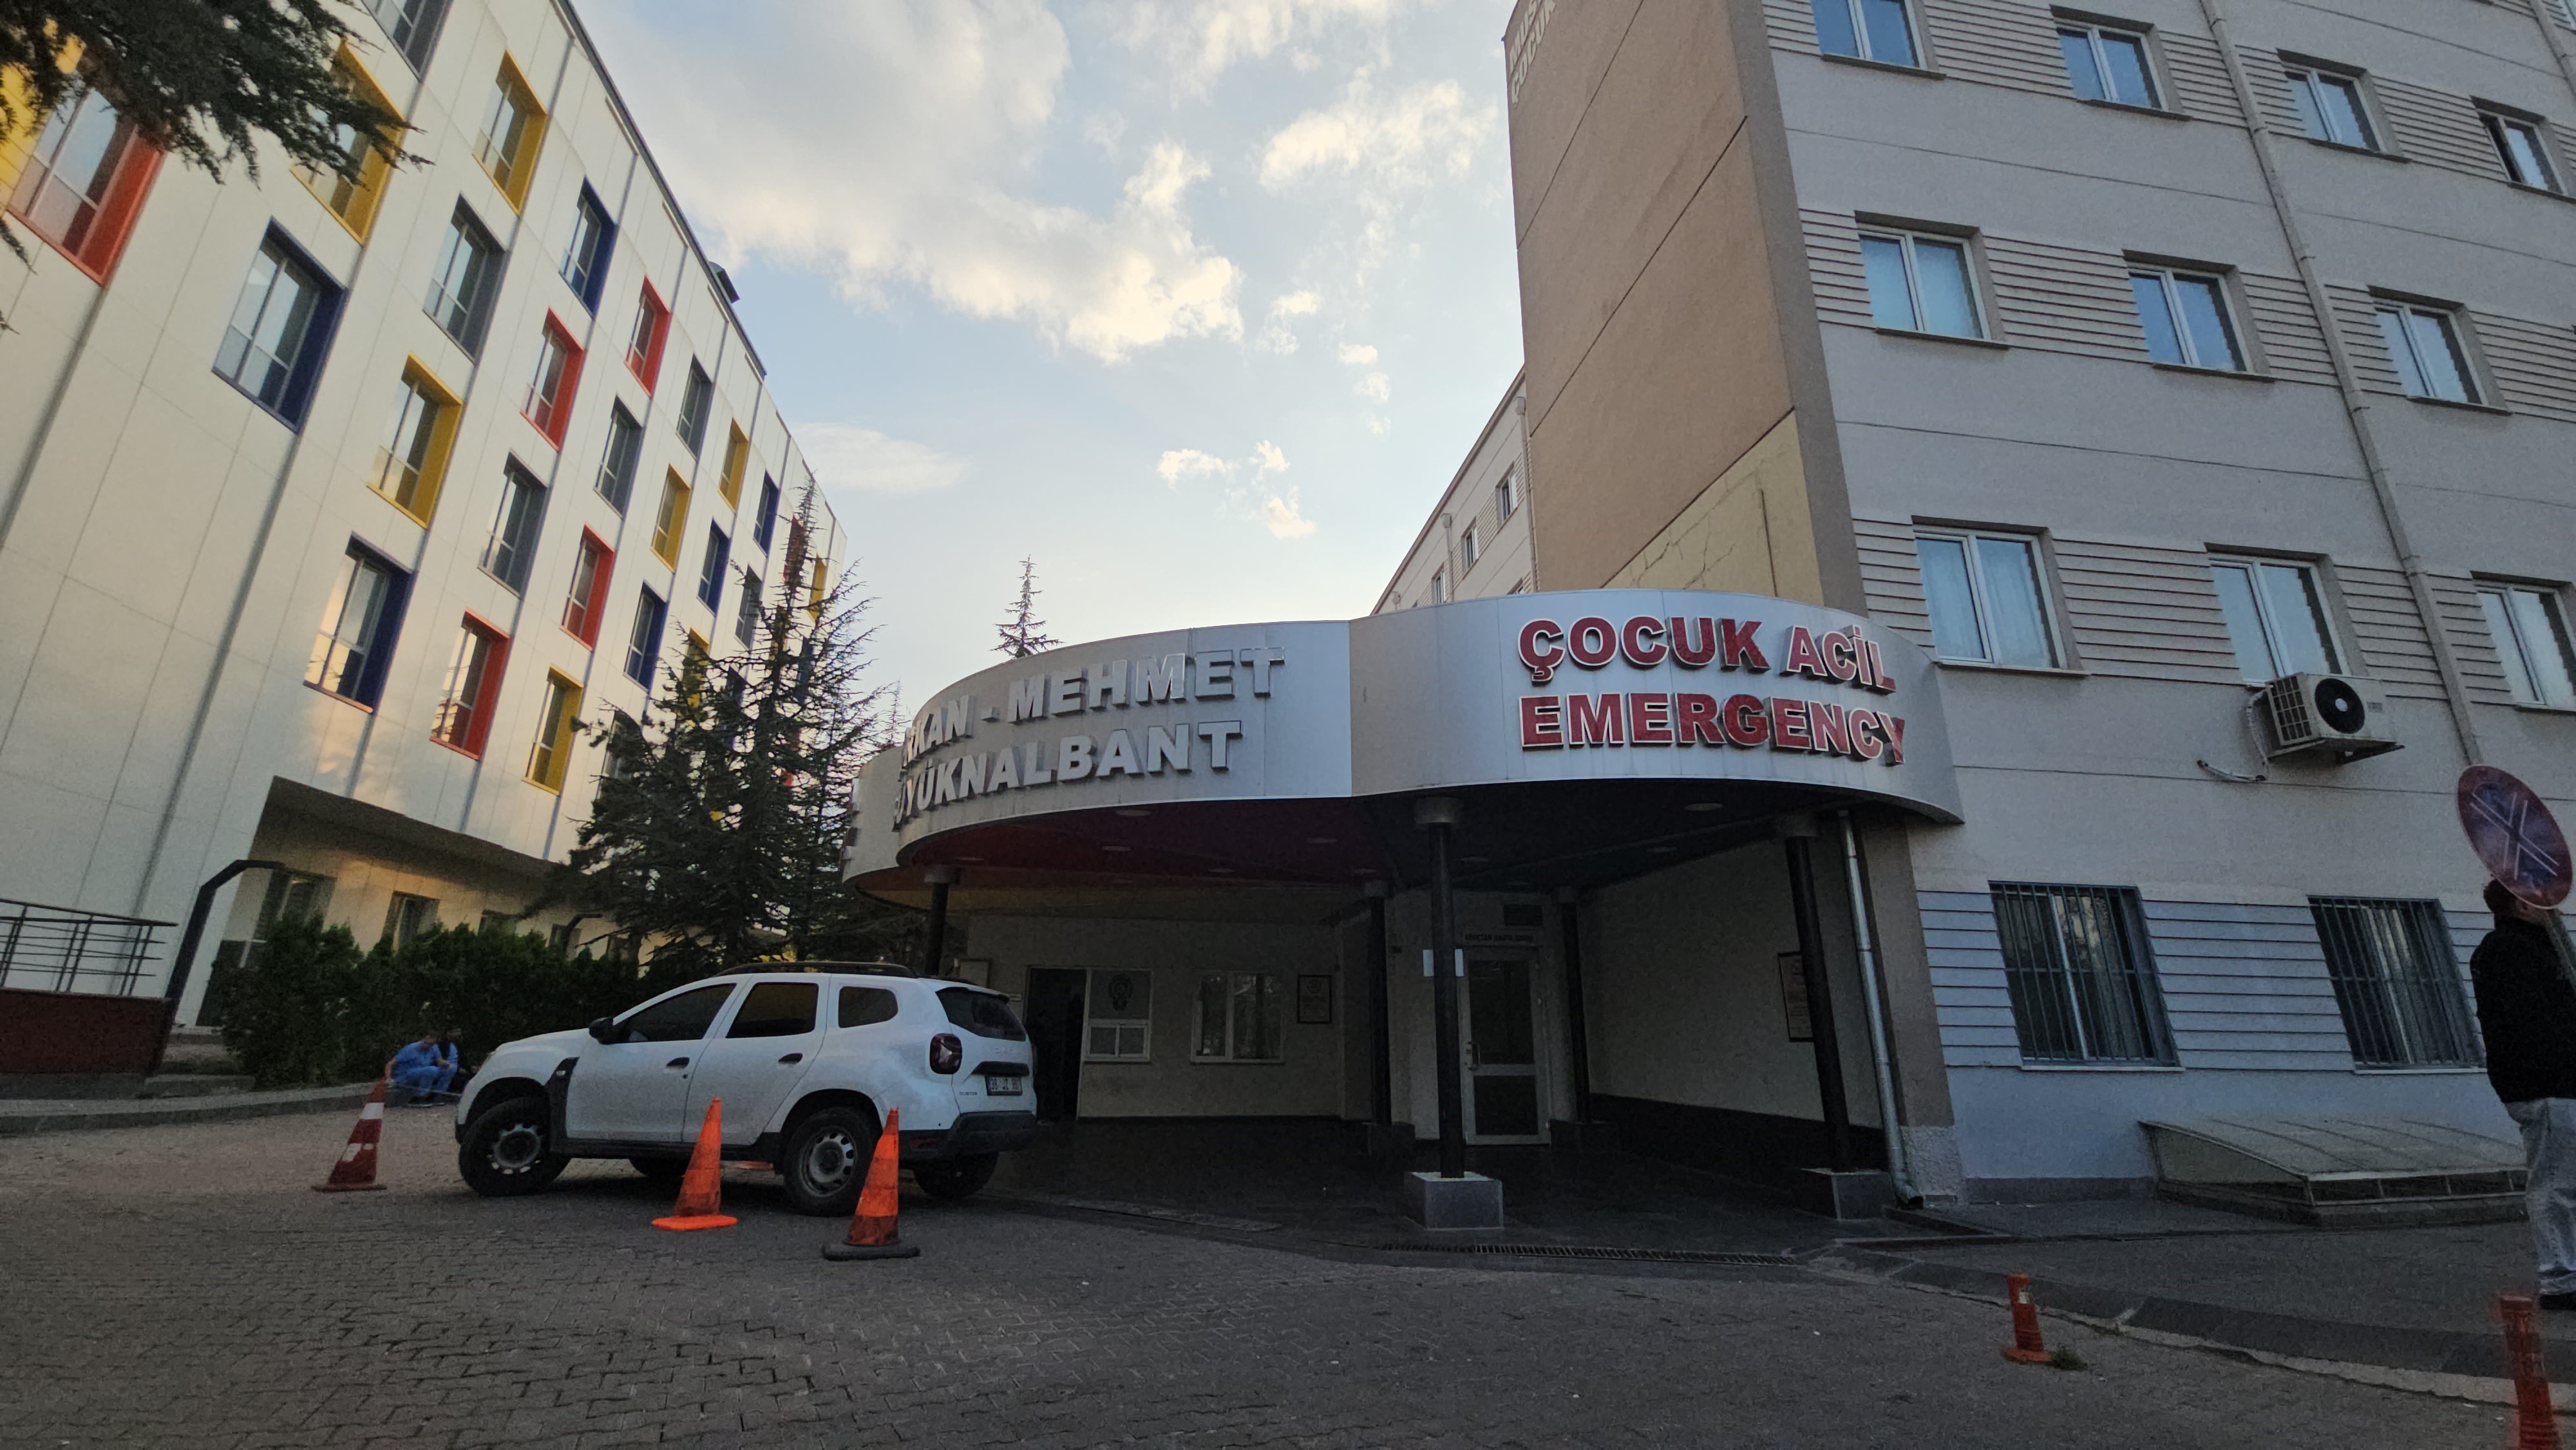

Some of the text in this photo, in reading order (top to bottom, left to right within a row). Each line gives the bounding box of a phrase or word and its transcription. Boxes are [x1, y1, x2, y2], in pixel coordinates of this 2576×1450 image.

[1009, 646, 1285, 725] MEHMET
[1518, 615, 1896, 695] ÇOCUK ACİL
[1519, 692, 1905, 766] EMERGENCY
